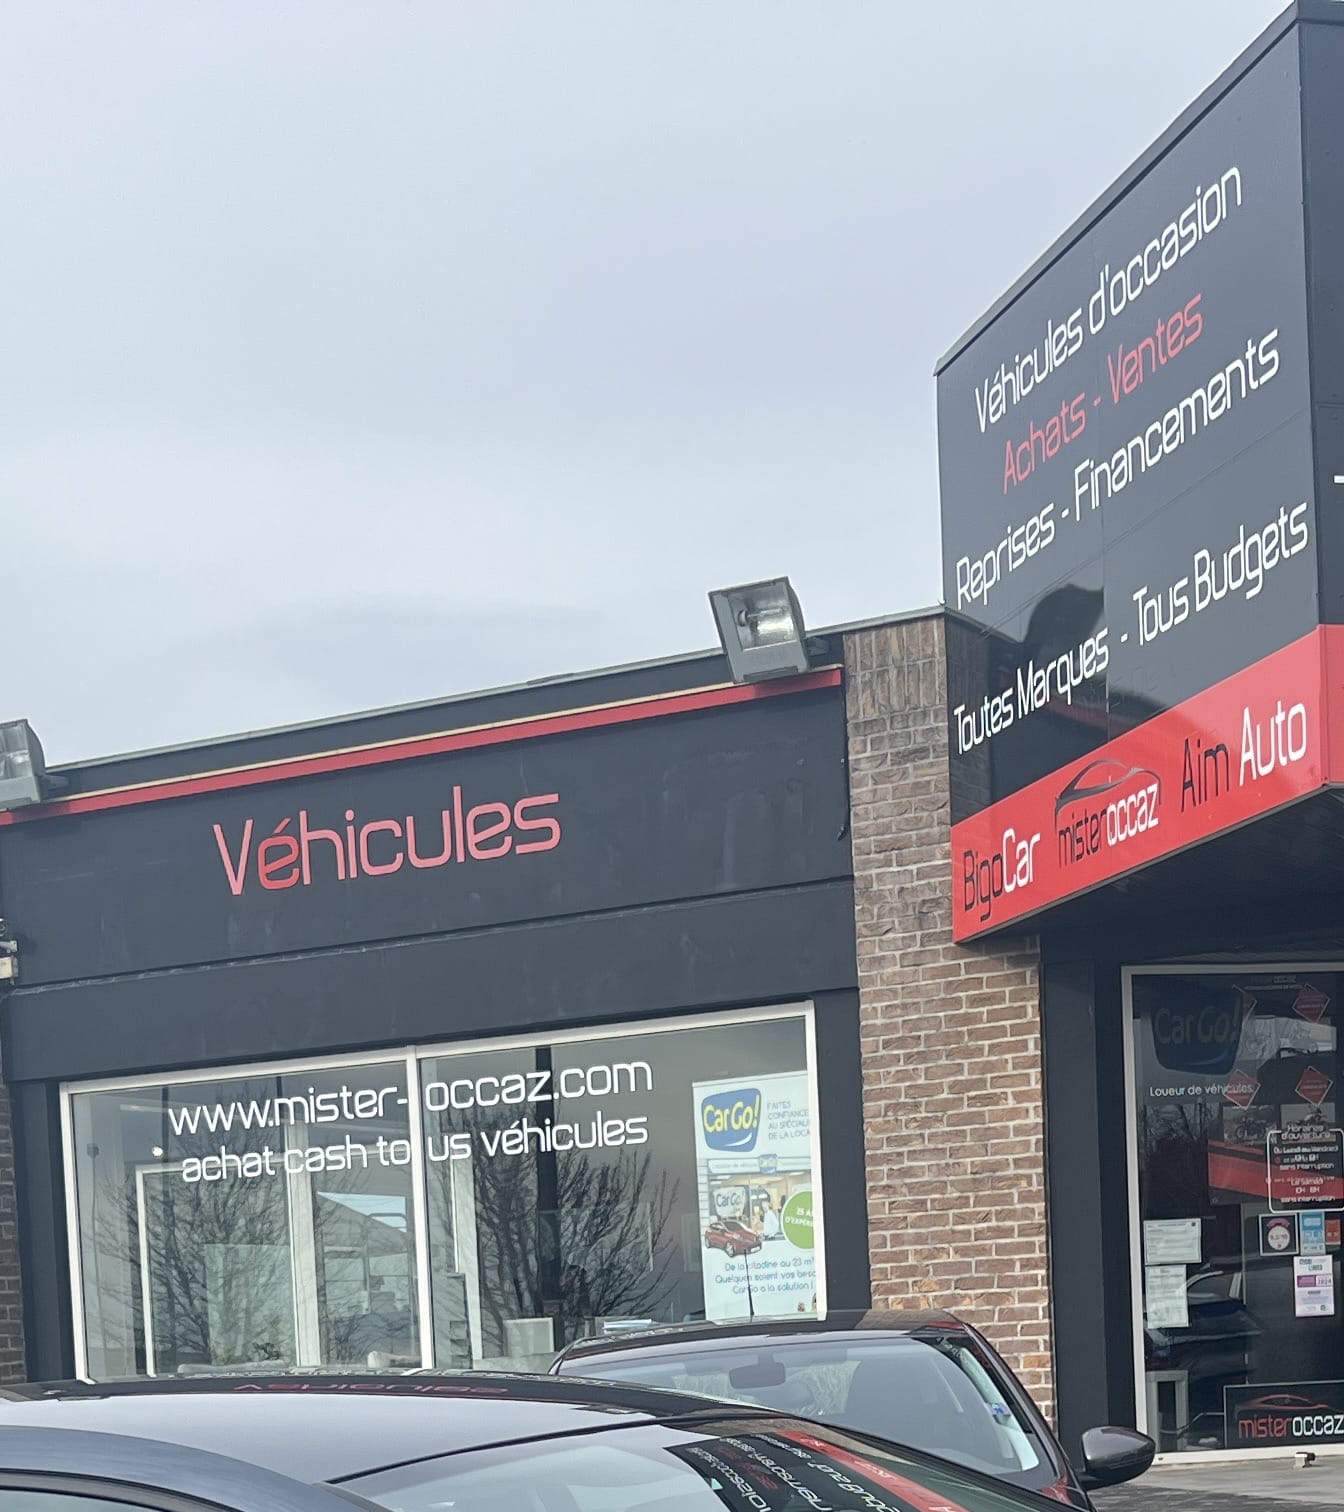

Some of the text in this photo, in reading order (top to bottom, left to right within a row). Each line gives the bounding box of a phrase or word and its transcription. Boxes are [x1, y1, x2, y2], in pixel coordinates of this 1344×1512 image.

[975, 167, 1242, 432] Véhicules d'occasion
[1003, 393, 1087, 494] Achats
[1107, 293, 1204, 404] Ventes
[956, 503, 1055, 610] Reprises
[1074, 328, 1280, 522] Financements
[954, 687, 1014, 755] Toutes
[1016, 628, 1109, 720] Marques
[1133, 577, 1189, 646] Tous
[1194, 502, 1308, 612] Budgets
[213, 786, 561, 896] Véhicules
[963, 828, 1041, 923] BigoCar
[1180, 738, 1230, 813] Aim
[1239, 699, 1307, 787] Auto
[182, 1145, 276, 1183] achat
[284, 1135, 368, 1174] cash
[480, 1110, 648, 1158] véhicules
[1150, 1086, 1185, 1097] Loueur
[1188, 1084, 1202, 1095] de
